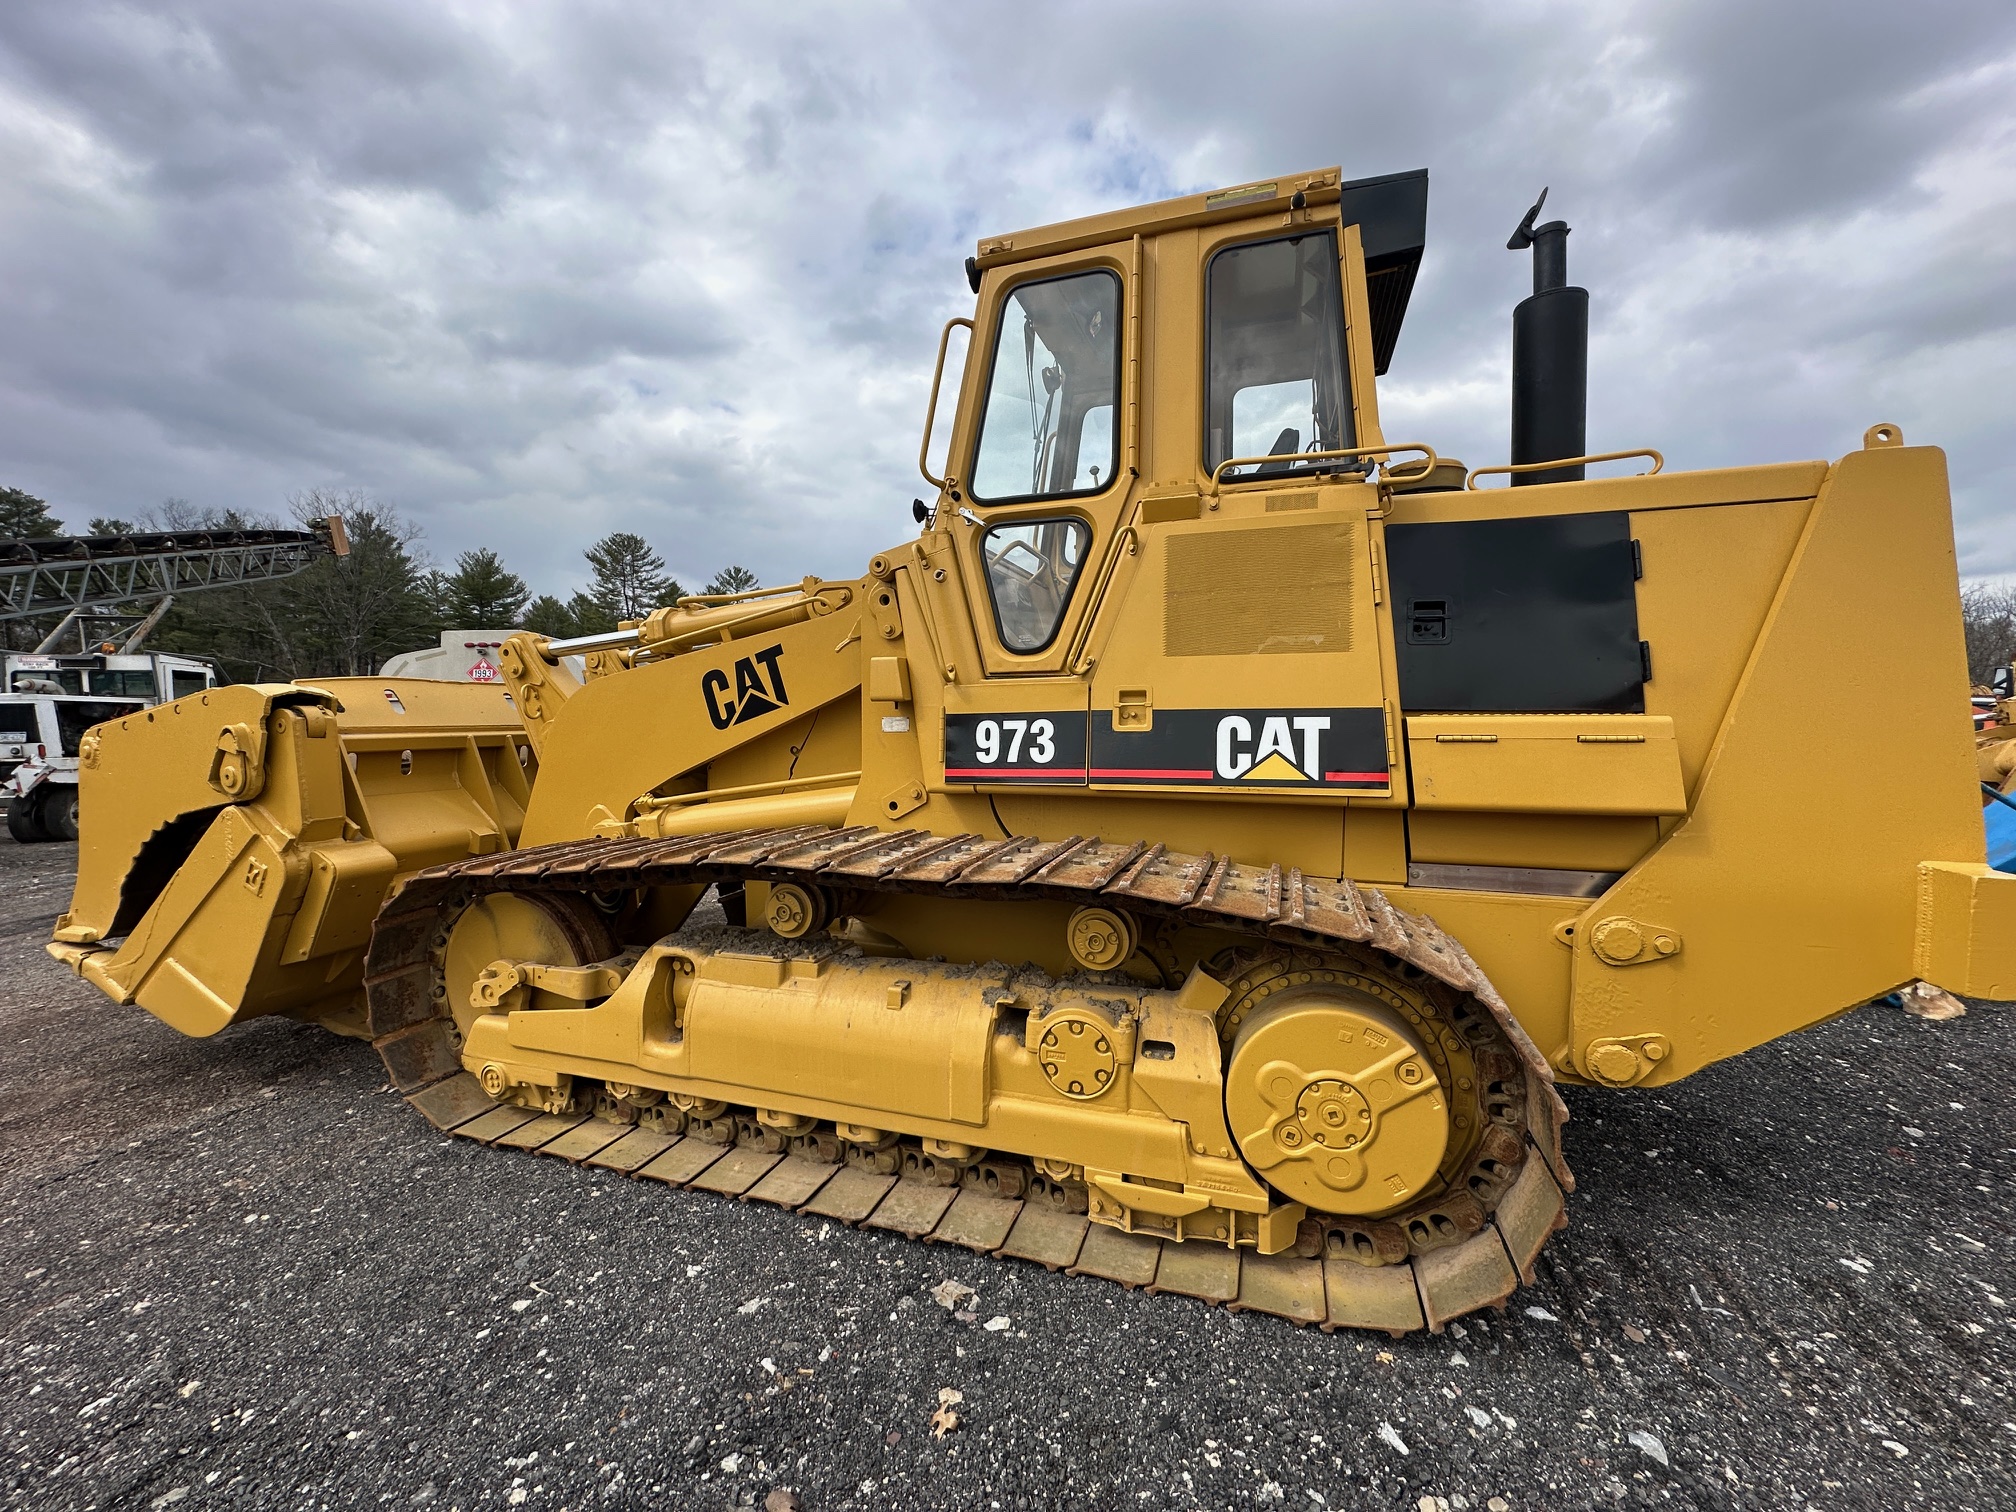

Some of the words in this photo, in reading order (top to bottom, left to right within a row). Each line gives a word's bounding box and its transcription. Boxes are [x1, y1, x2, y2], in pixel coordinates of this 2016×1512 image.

[474, 670, 492, 678] 1993
[702, 643, 790, 730] CAT
[975, 718, 1055, 764] 973
[1216, 715, 1331, 781] CAT
